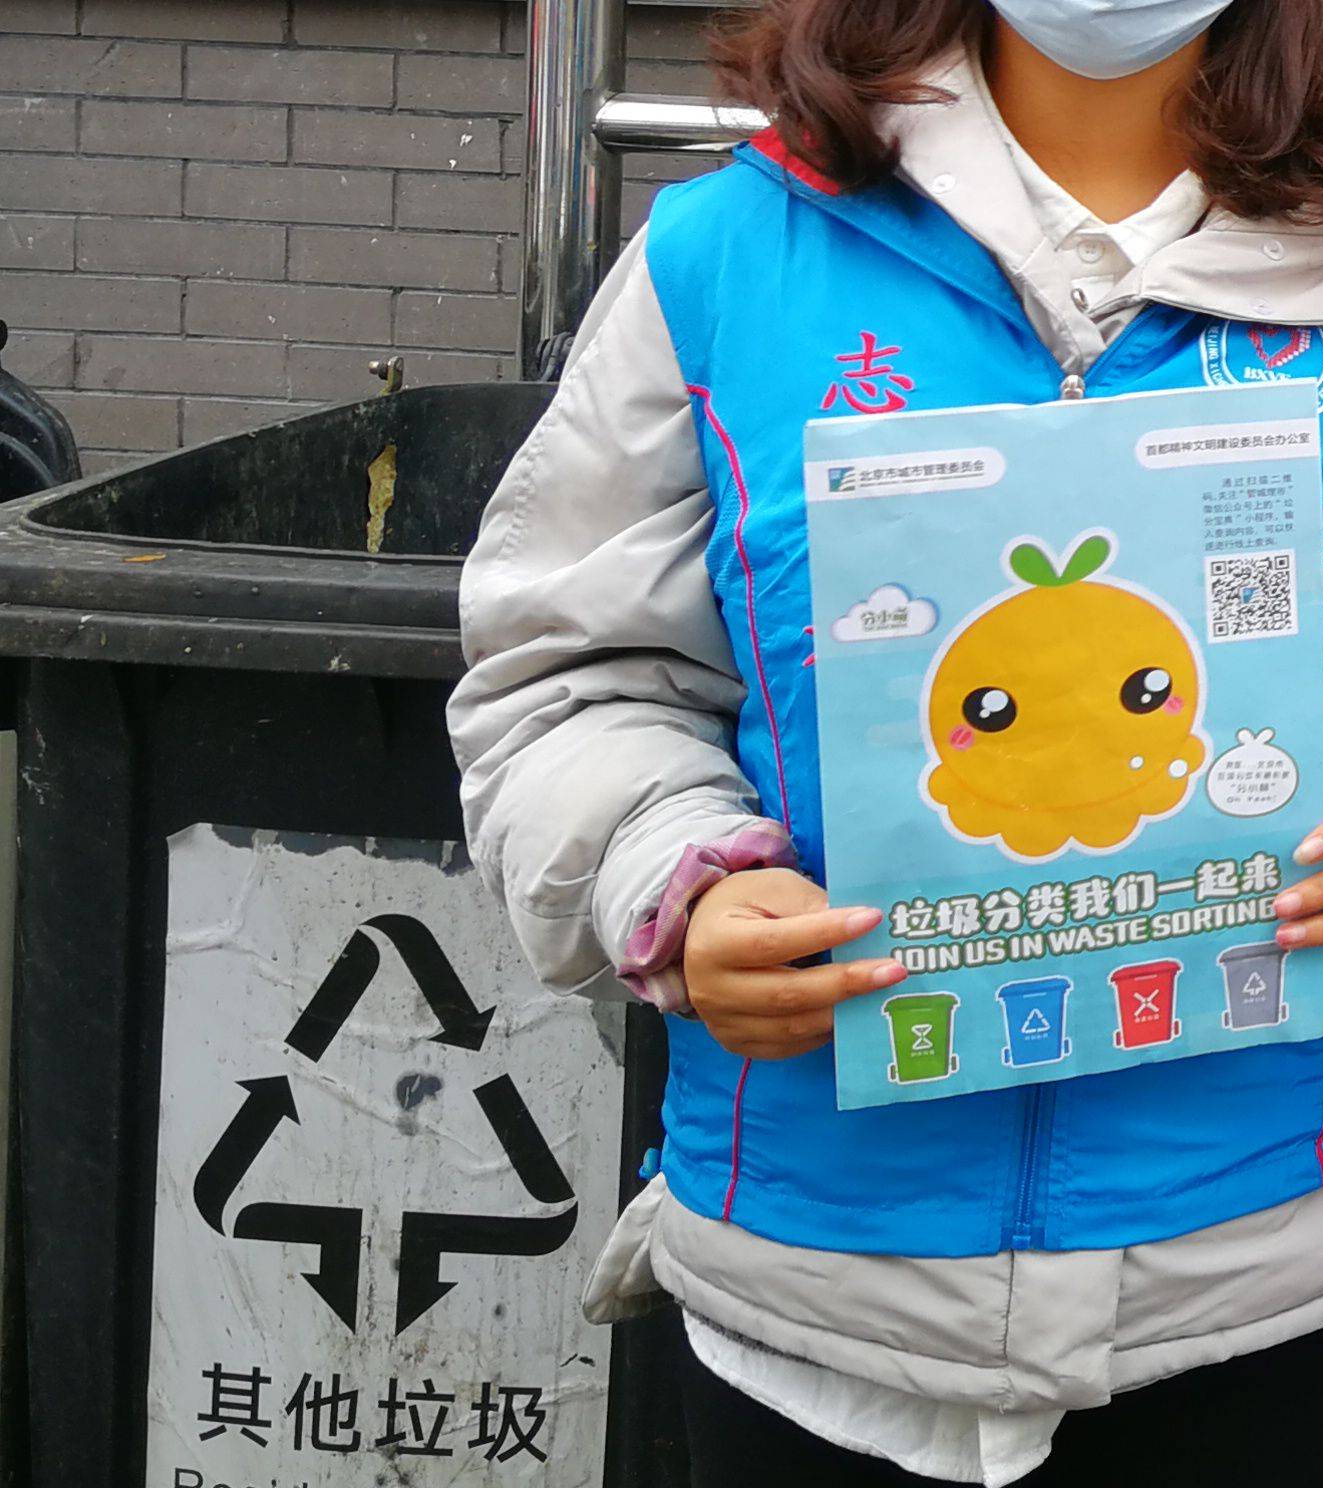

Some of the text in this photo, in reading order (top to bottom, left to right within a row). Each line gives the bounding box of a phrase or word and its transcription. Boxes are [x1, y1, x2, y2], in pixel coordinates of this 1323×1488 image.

[821, 330, 915, 413] 志
[891, 853, 1281, 939] 垃圾分类我们一起来
[966, 941, 1001, 965] US
[1009, 933, 1043, 960] IN
[1048, 918, 1147, 953] WASTE
[197, 1362, 548, 1464] 其他垃圾
